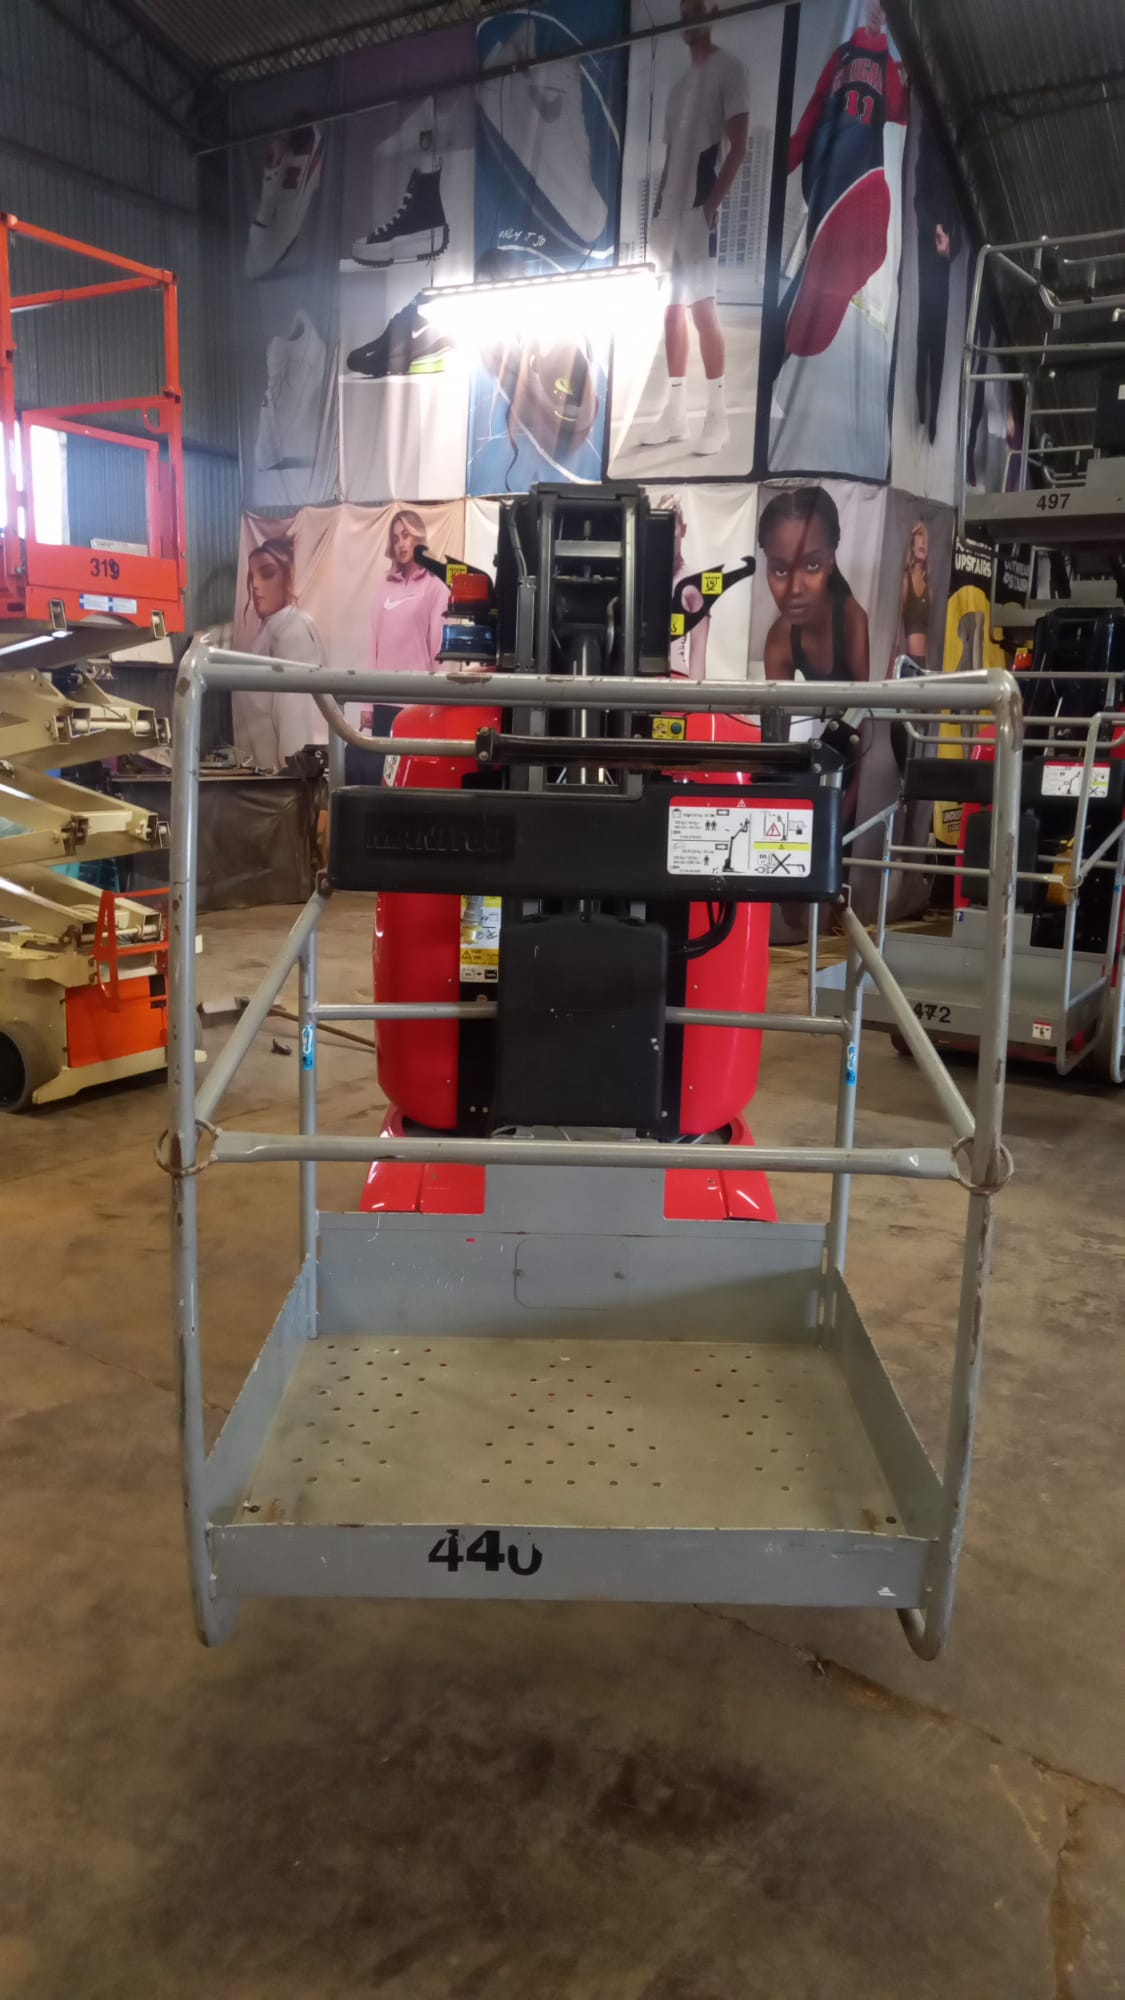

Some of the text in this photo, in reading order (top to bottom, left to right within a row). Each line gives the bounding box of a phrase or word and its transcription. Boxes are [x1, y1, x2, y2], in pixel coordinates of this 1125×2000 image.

[1036, 493, 1071, 511] 497
[90, 558, 120, 580] 319
[954, 553, 993, 578] UPSTAIRS
[913, 1002, 952, 1024] 472
